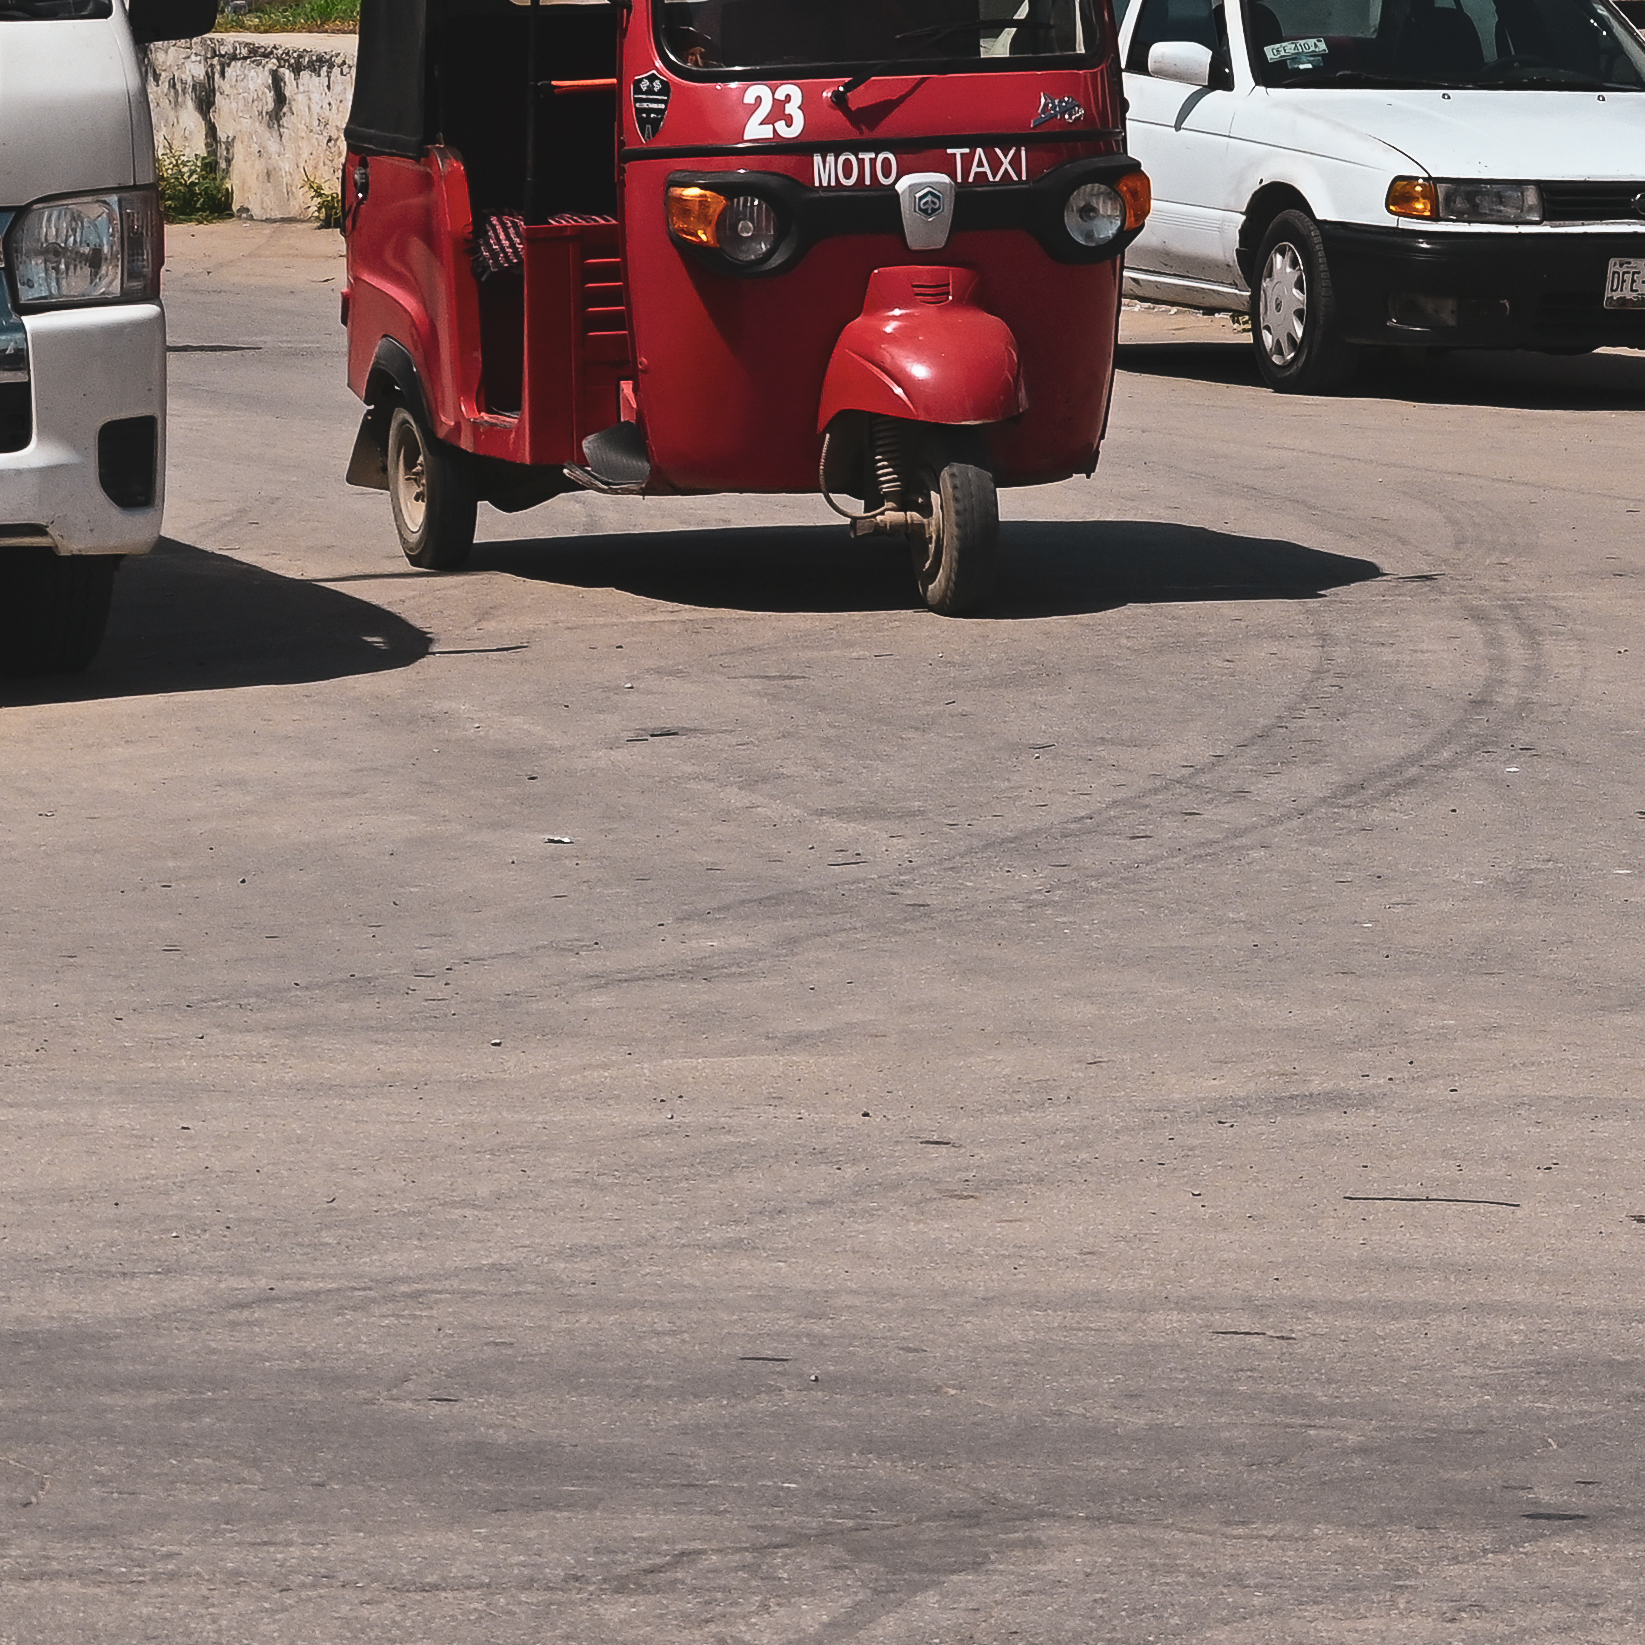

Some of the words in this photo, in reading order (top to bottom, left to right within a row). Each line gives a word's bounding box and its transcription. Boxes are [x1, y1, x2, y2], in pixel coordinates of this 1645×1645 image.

[742, 84, 805, 141] 23
[813, 151, 898, 187] MOTO
[946, 146, 1028, 183] TAXI
